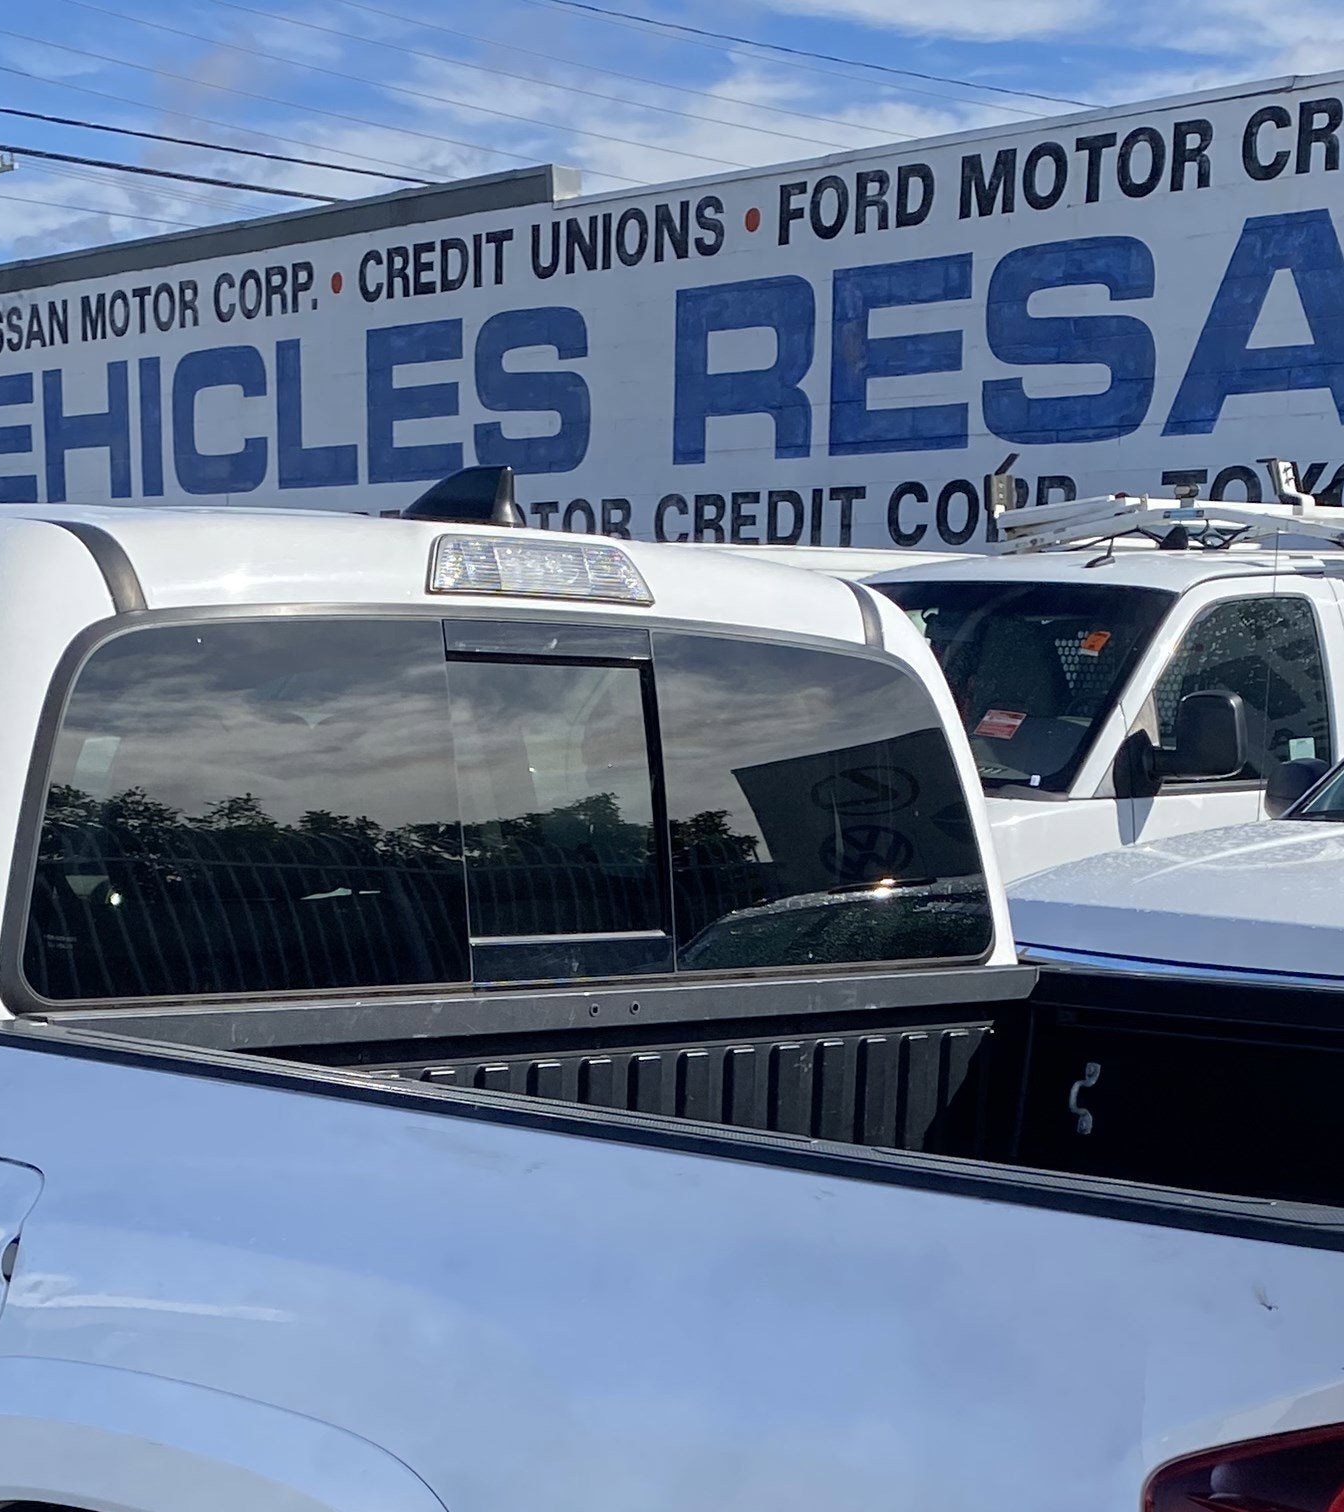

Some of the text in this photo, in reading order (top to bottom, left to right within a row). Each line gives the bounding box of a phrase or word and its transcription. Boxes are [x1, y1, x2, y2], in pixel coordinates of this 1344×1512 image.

[80, 278, 200, 342] MOTOR
[213, 261, 319, 323] CORP.
[358, 228, 514, 302] CREDIT
[531, 195, 725, 280] UNIONS
[777, 164, 935, 246] FORD
[959, 117, 1214, 221] MOTOR
[516, 498, 632, 541] TOR
[655, 485, 867, 548] CREDIT
